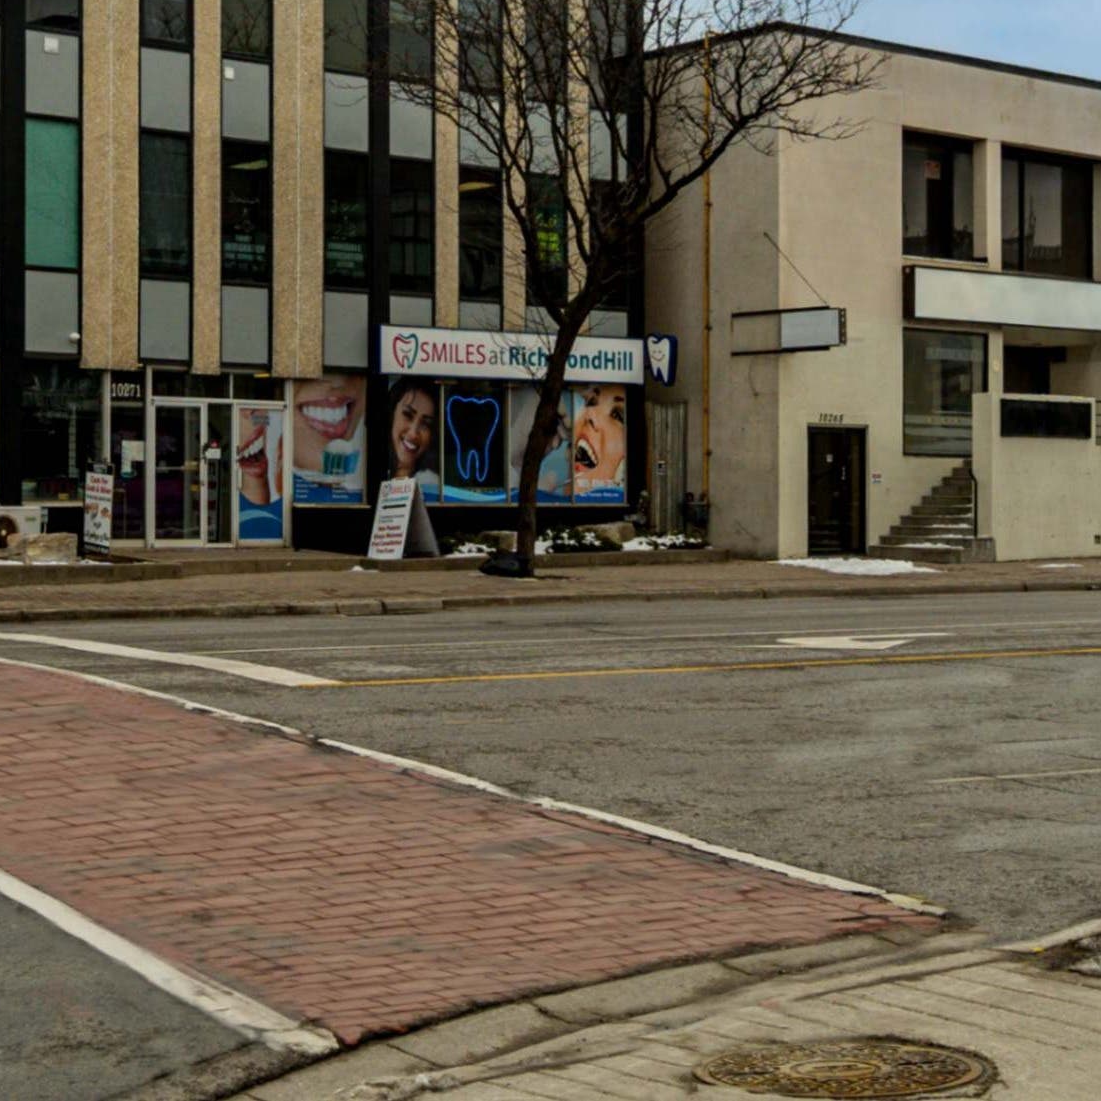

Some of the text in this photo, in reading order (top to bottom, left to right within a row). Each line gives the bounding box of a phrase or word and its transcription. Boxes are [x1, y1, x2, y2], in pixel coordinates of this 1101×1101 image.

[420, 341, 634, 371] SMILES at RichondHill
[111, 383, 141, 398] 10271
